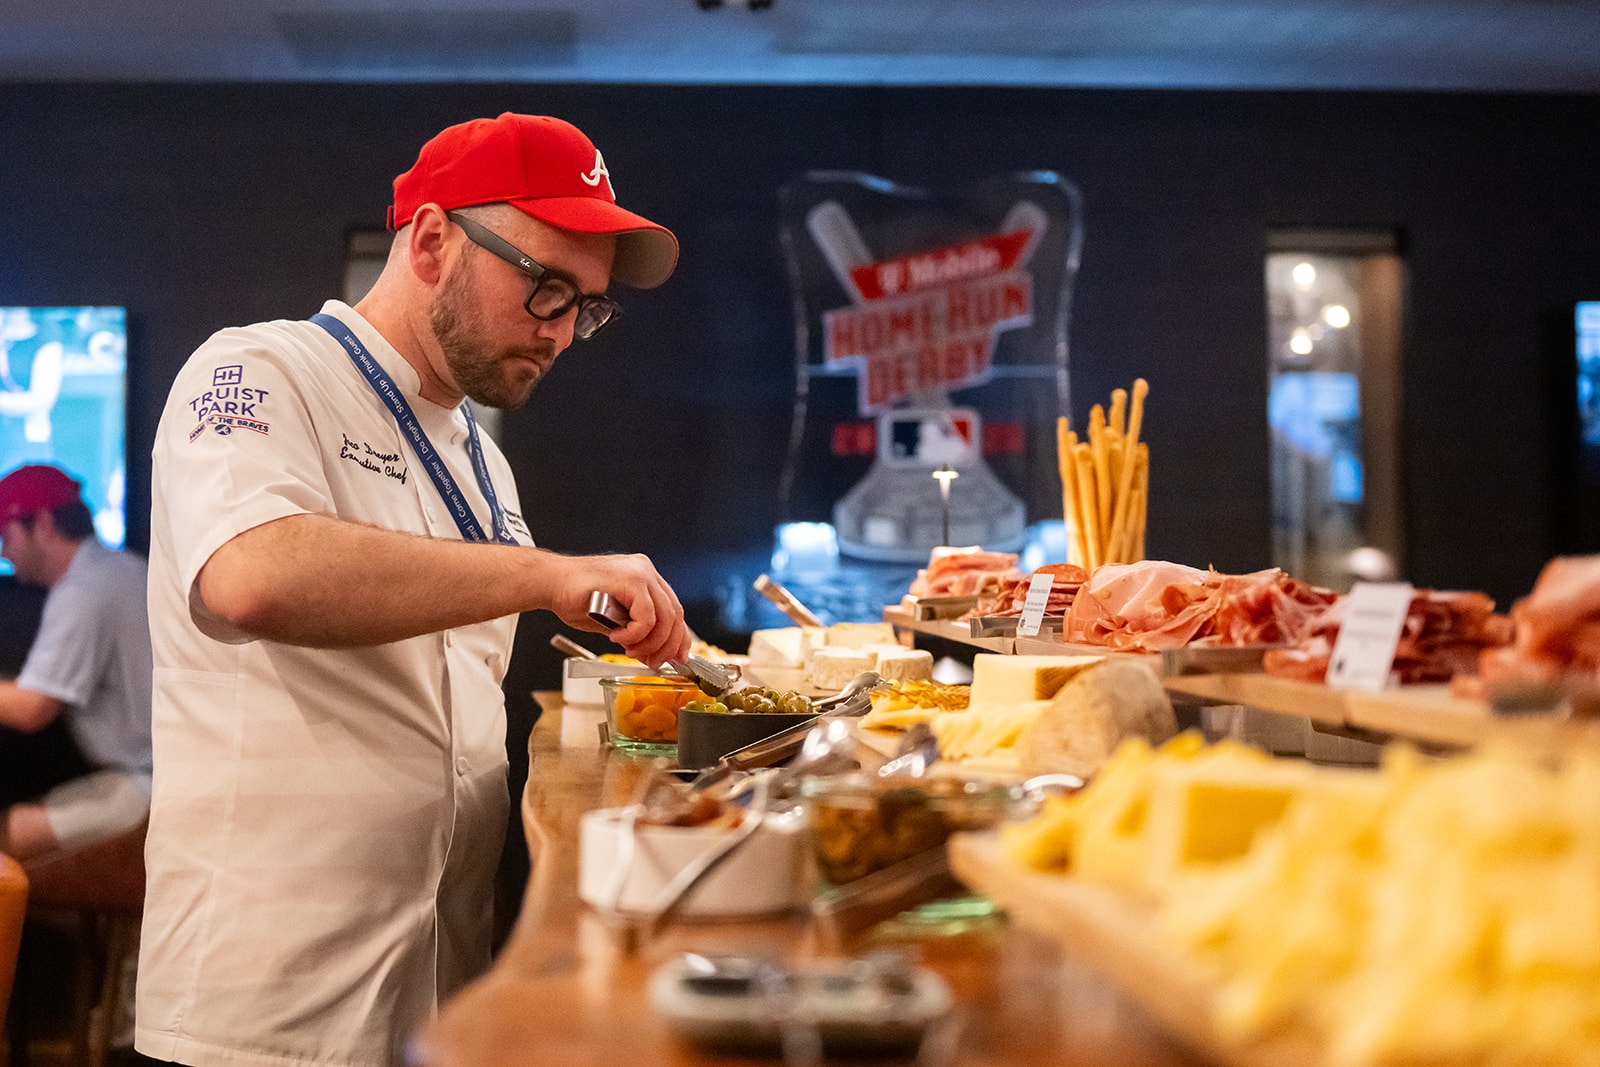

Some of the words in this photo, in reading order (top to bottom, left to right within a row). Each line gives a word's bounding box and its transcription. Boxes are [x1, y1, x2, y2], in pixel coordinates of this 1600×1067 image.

[581, 149, 616, 201] A
[830, 301, 932, 360] HOME
[946, 279, 1030, 333] RUN
[344, 335, 361, 355] Guest
[360, 354, 375, 374] Think
[865, 333, 988, 406] DERBY
[379, 379, 390, 392] Up
[189, 387, 269, 411] TRUIST
[386, 390, 404, 413] Stand
[198, 401, 256, 422] PARK
[218, 417, 234, 425] THE
[237, 420, 269, 432] BRAVES
[406, 420, 421, 442] Right
[420, 441, 429, 454] Do
[385, 466, 407, 485] Chef
[431, 461, 453, 496] Together
[451, 494, 467, 518] Come
